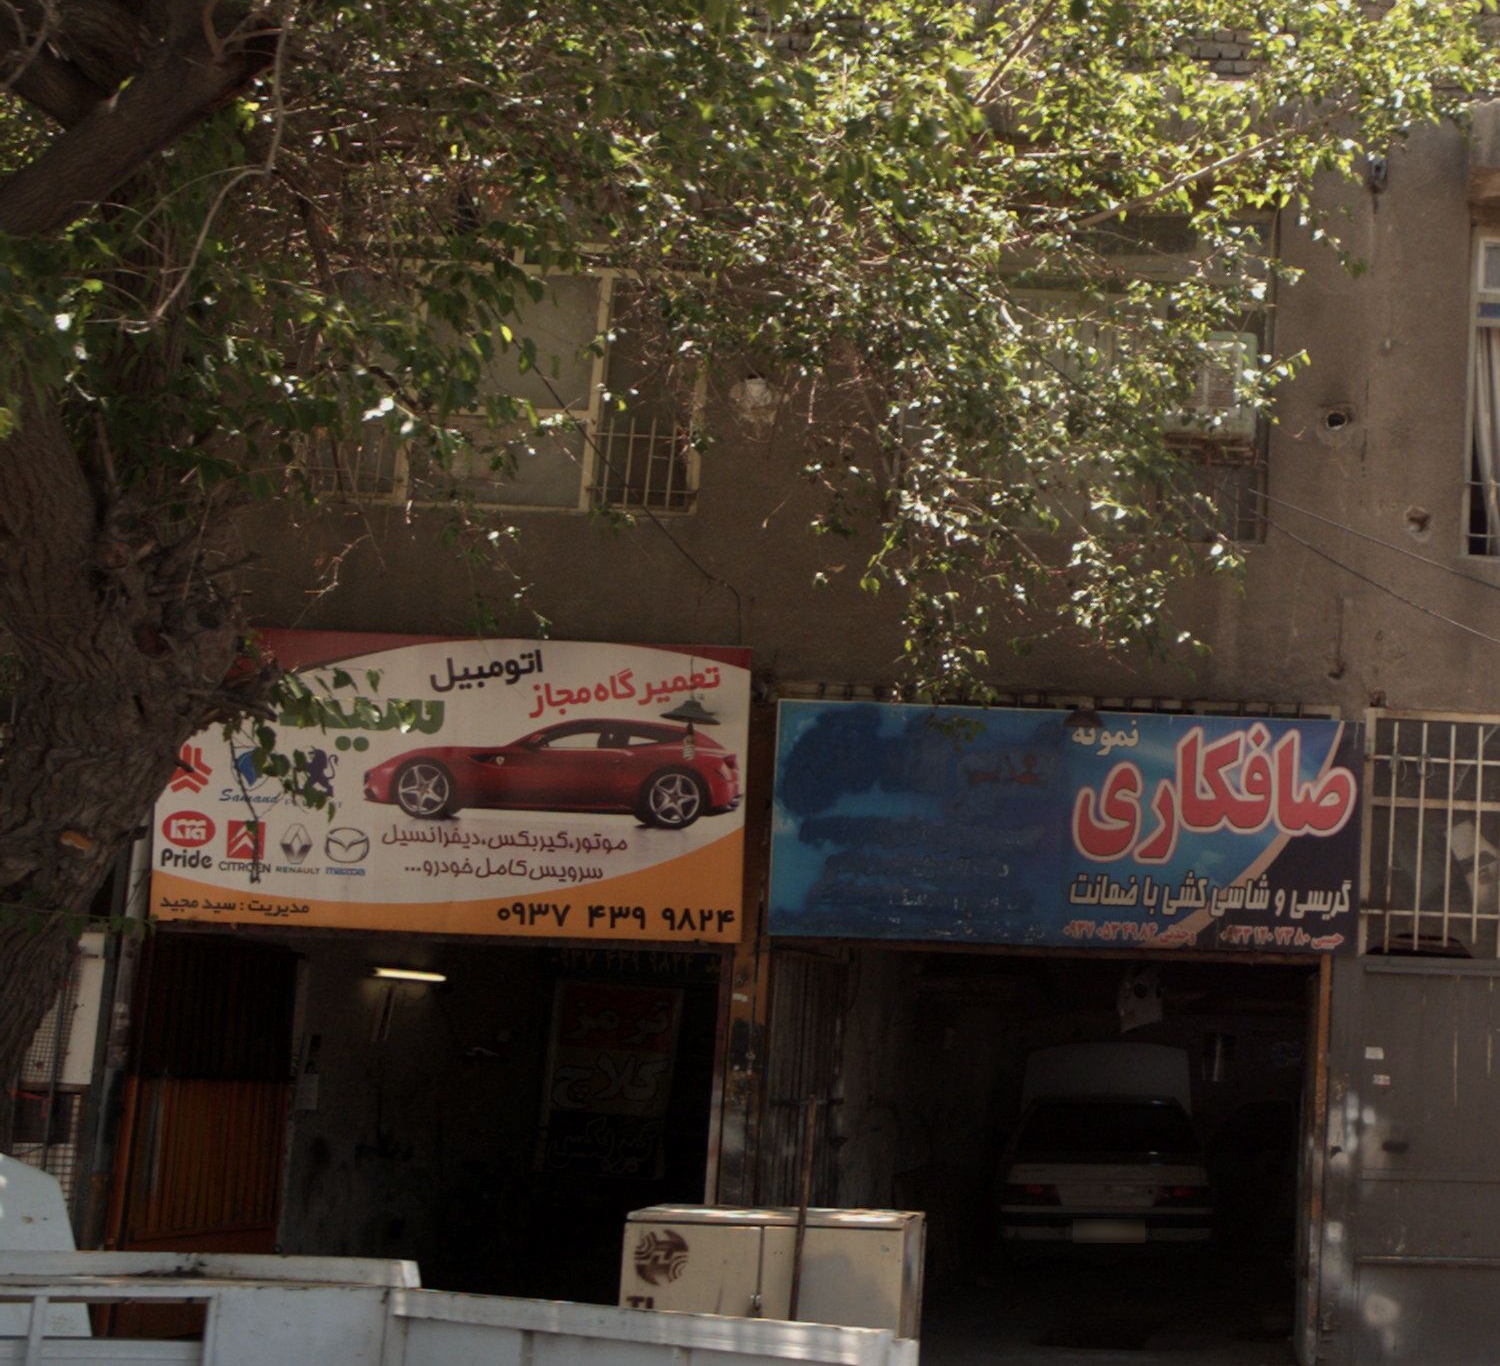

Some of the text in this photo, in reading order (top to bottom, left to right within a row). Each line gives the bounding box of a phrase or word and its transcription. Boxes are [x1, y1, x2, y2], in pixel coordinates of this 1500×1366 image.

[430, 649, 543, 693] اتومبیل
[529, 683, 593, 718] مجاز
[1071, 720, 1139, 756] نمونه
[218, 788, 282, 804] Samand
[1072, 721, 1357, 865] صافکاری
[161, 848, 213, 869] Pride
[275, 866, 320, 875] RENAULT
[325, 865, 366, 876] mazda
[476, 856, 528, 879] کامل
[529, 861, 604, 883] سرویس
[160, 896, 198, 913] مجید
[1069, 871, 1139, 908] ضمانت
[1143, 876, 1159, 916] با
[1161, 869, 1209, 918] کشی
[1210, 872, 1270, 918] شاسی
[1274, 890, 1286, 916] و
[202, 899, 237, 912] سید
[497, 902, 735, 933] ۰۹۳۷ ۴۳۹ ۹۸۲۴
[551, 1050, 670, 1113] کلاچ
